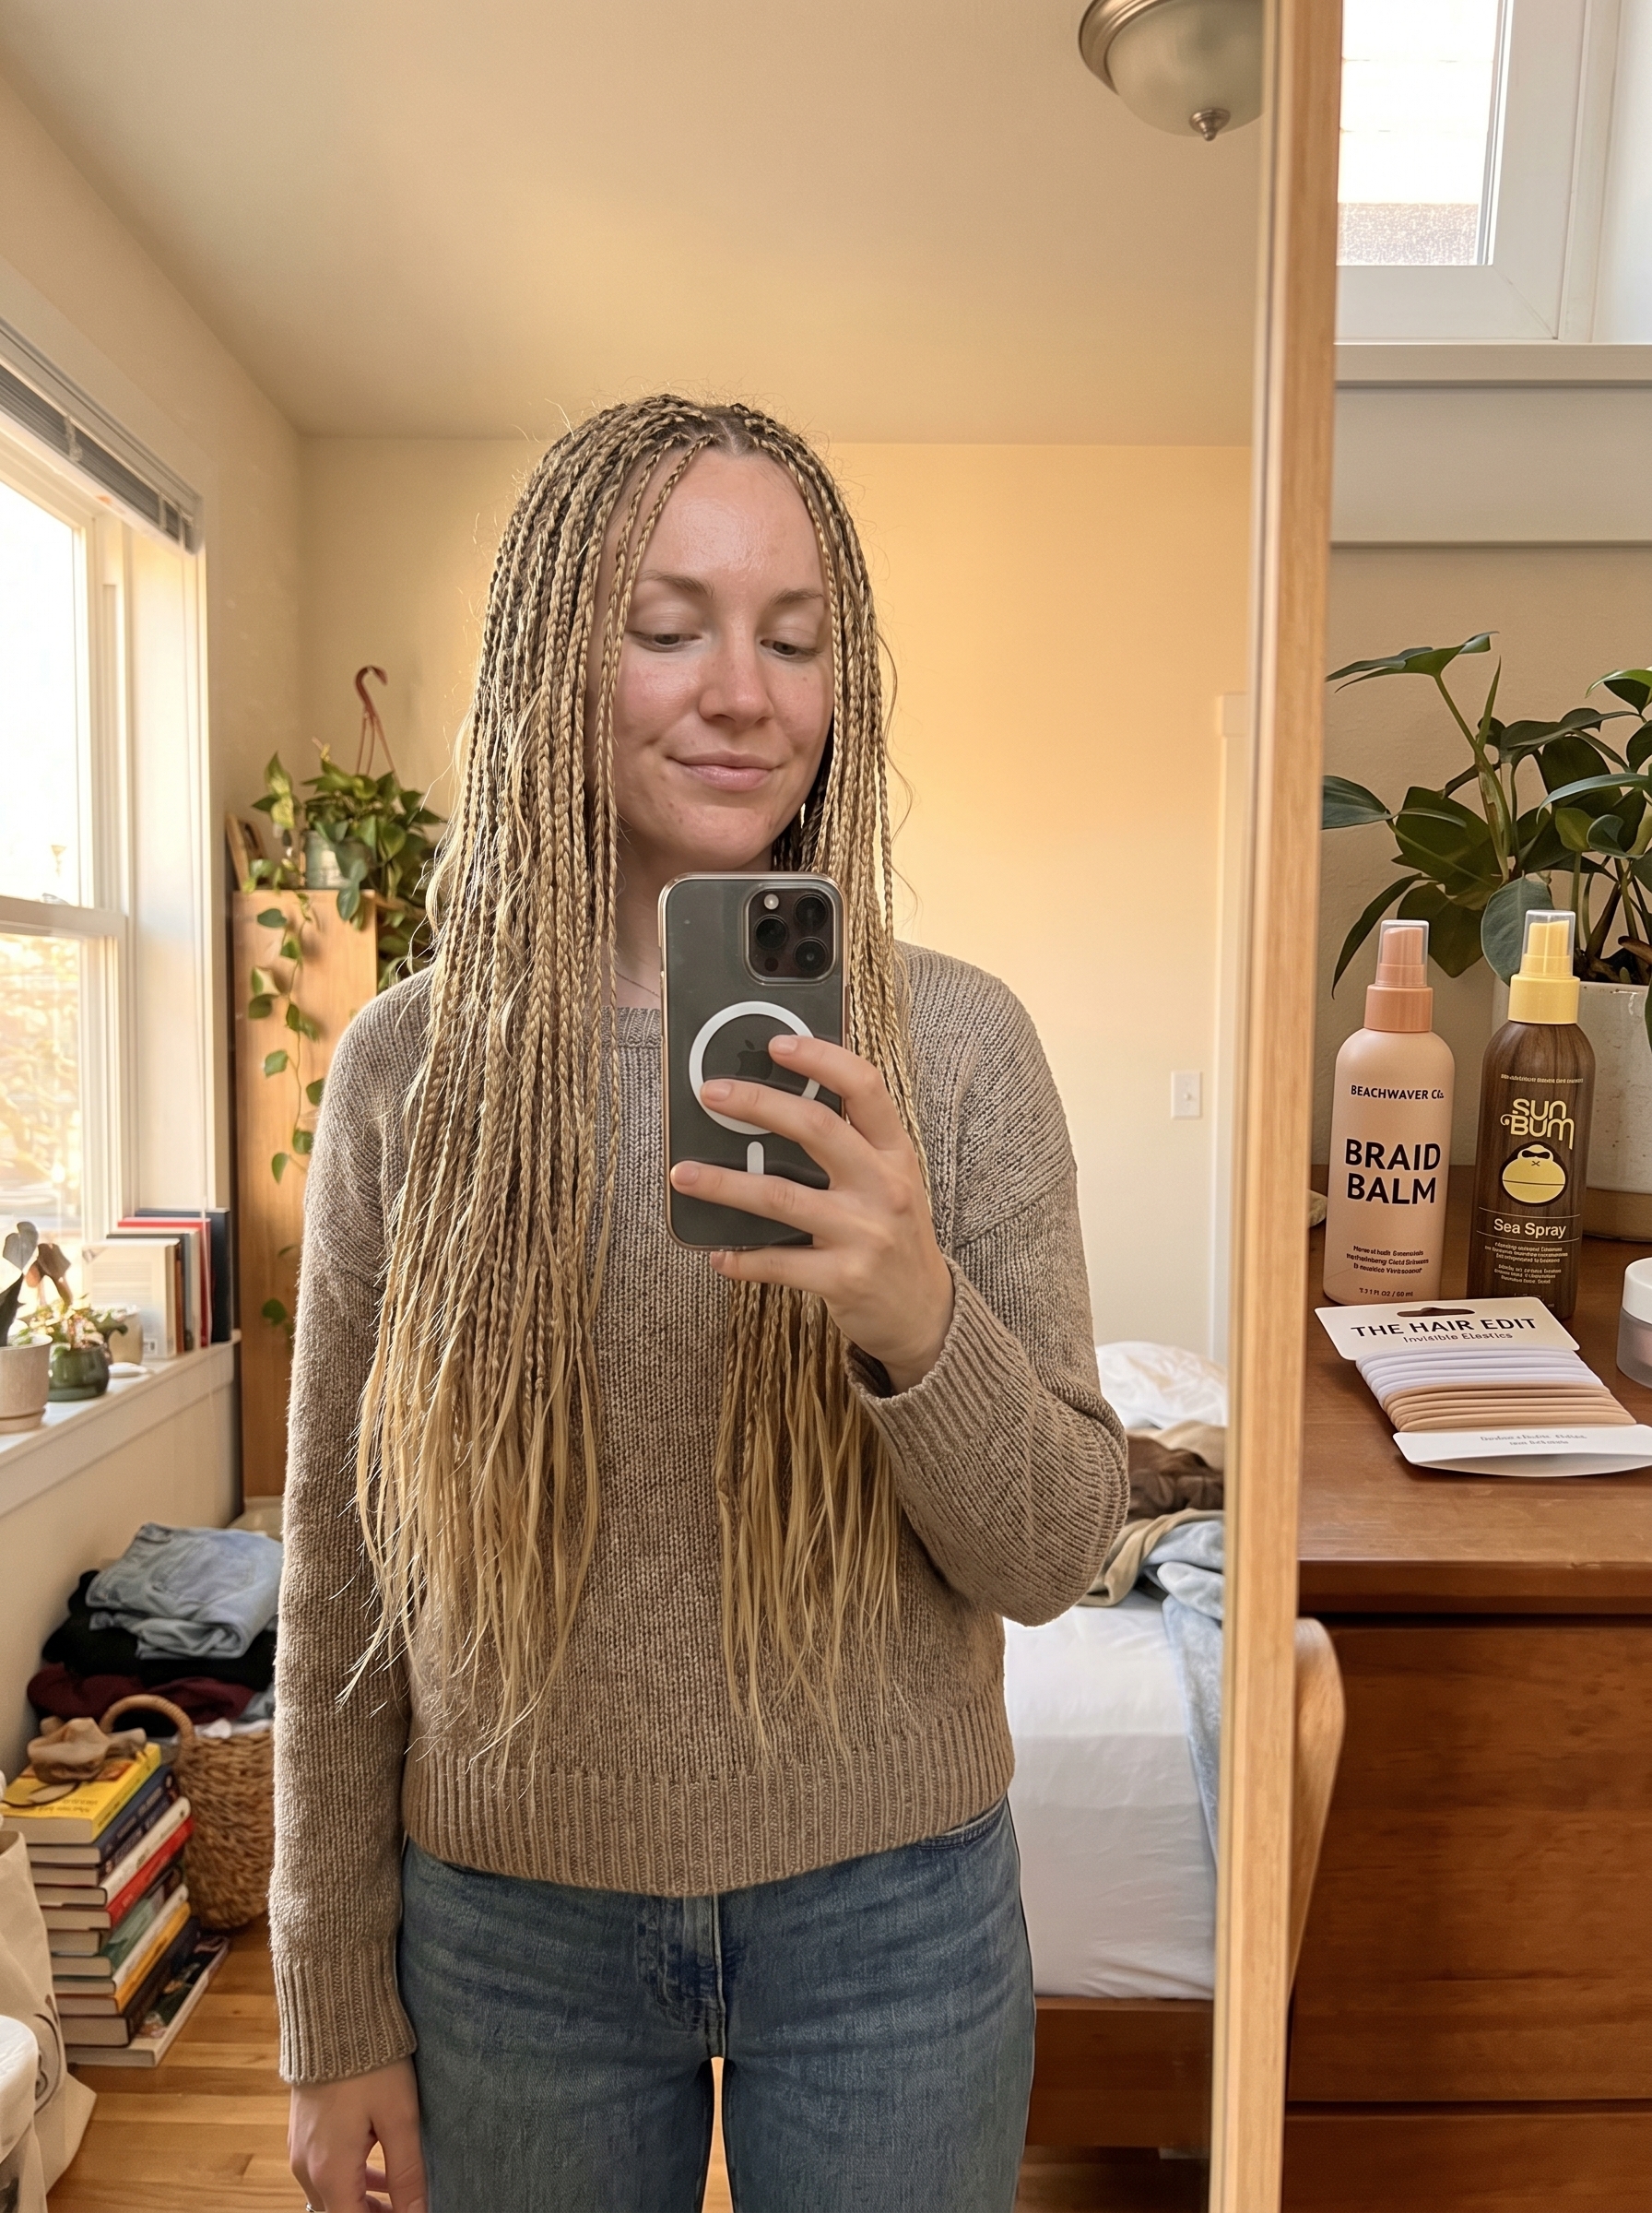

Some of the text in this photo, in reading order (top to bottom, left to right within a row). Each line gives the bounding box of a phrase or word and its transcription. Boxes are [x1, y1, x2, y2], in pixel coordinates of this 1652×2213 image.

[1351, 1084, 1429, 1100] BEACHWAVER
[1345, 1138, 1441, 1171] BRAID
[1347, 1172, 1436, 1205] BALM
[1493, 1218, 1567, 1239] Sea Spray
[1351, 1319, 1537, 1337] THE HAIR EDIT
